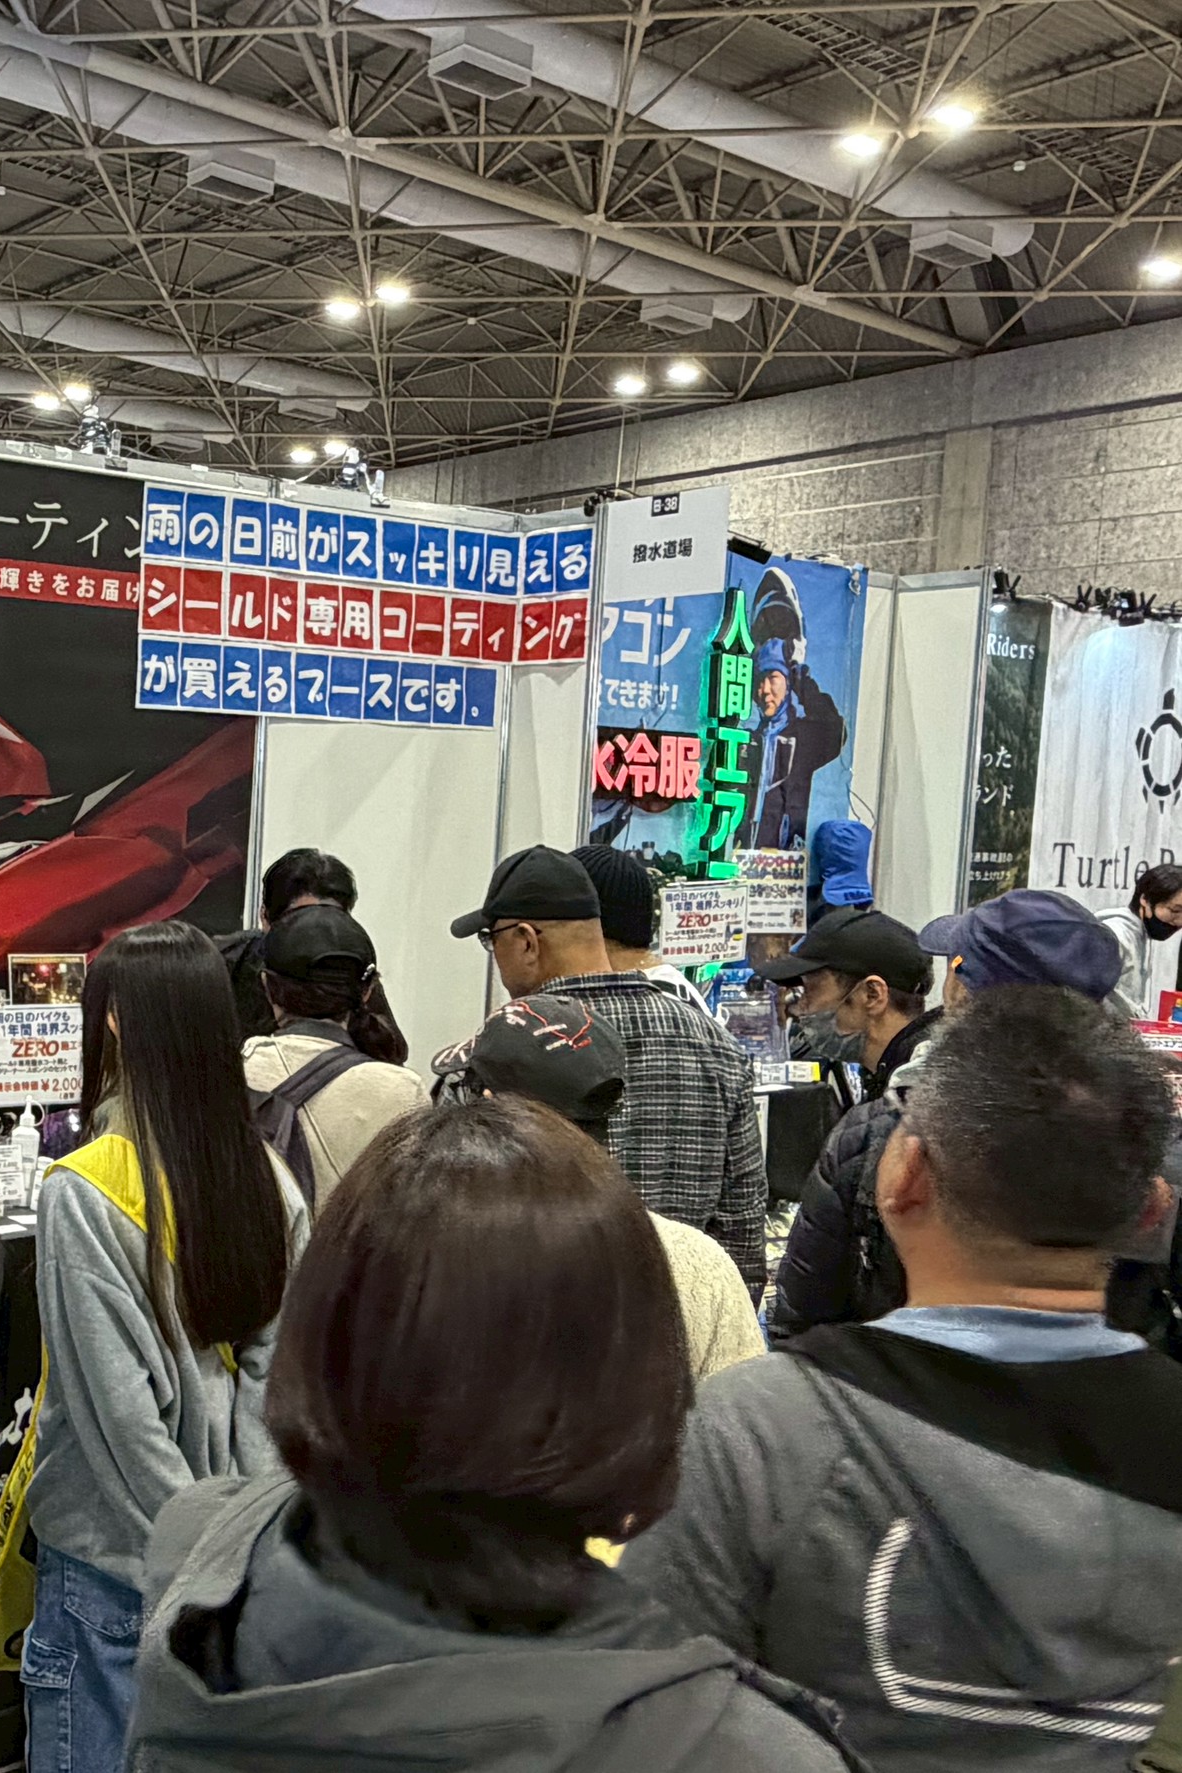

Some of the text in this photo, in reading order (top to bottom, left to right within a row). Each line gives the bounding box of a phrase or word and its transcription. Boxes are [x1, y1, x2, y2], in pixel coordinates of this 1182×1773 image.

[147, 503, 589, 587] 雨の日前がスッキリ見える
[632, 537, 693, 563] 撥水道場
[147, 578, 586, 650] シールド専用コーティング
[986, 632, 1036, 661] Riders
[677, 913, 711, 928] ZERO
[12, 1040, 60, 1058] ZERO
